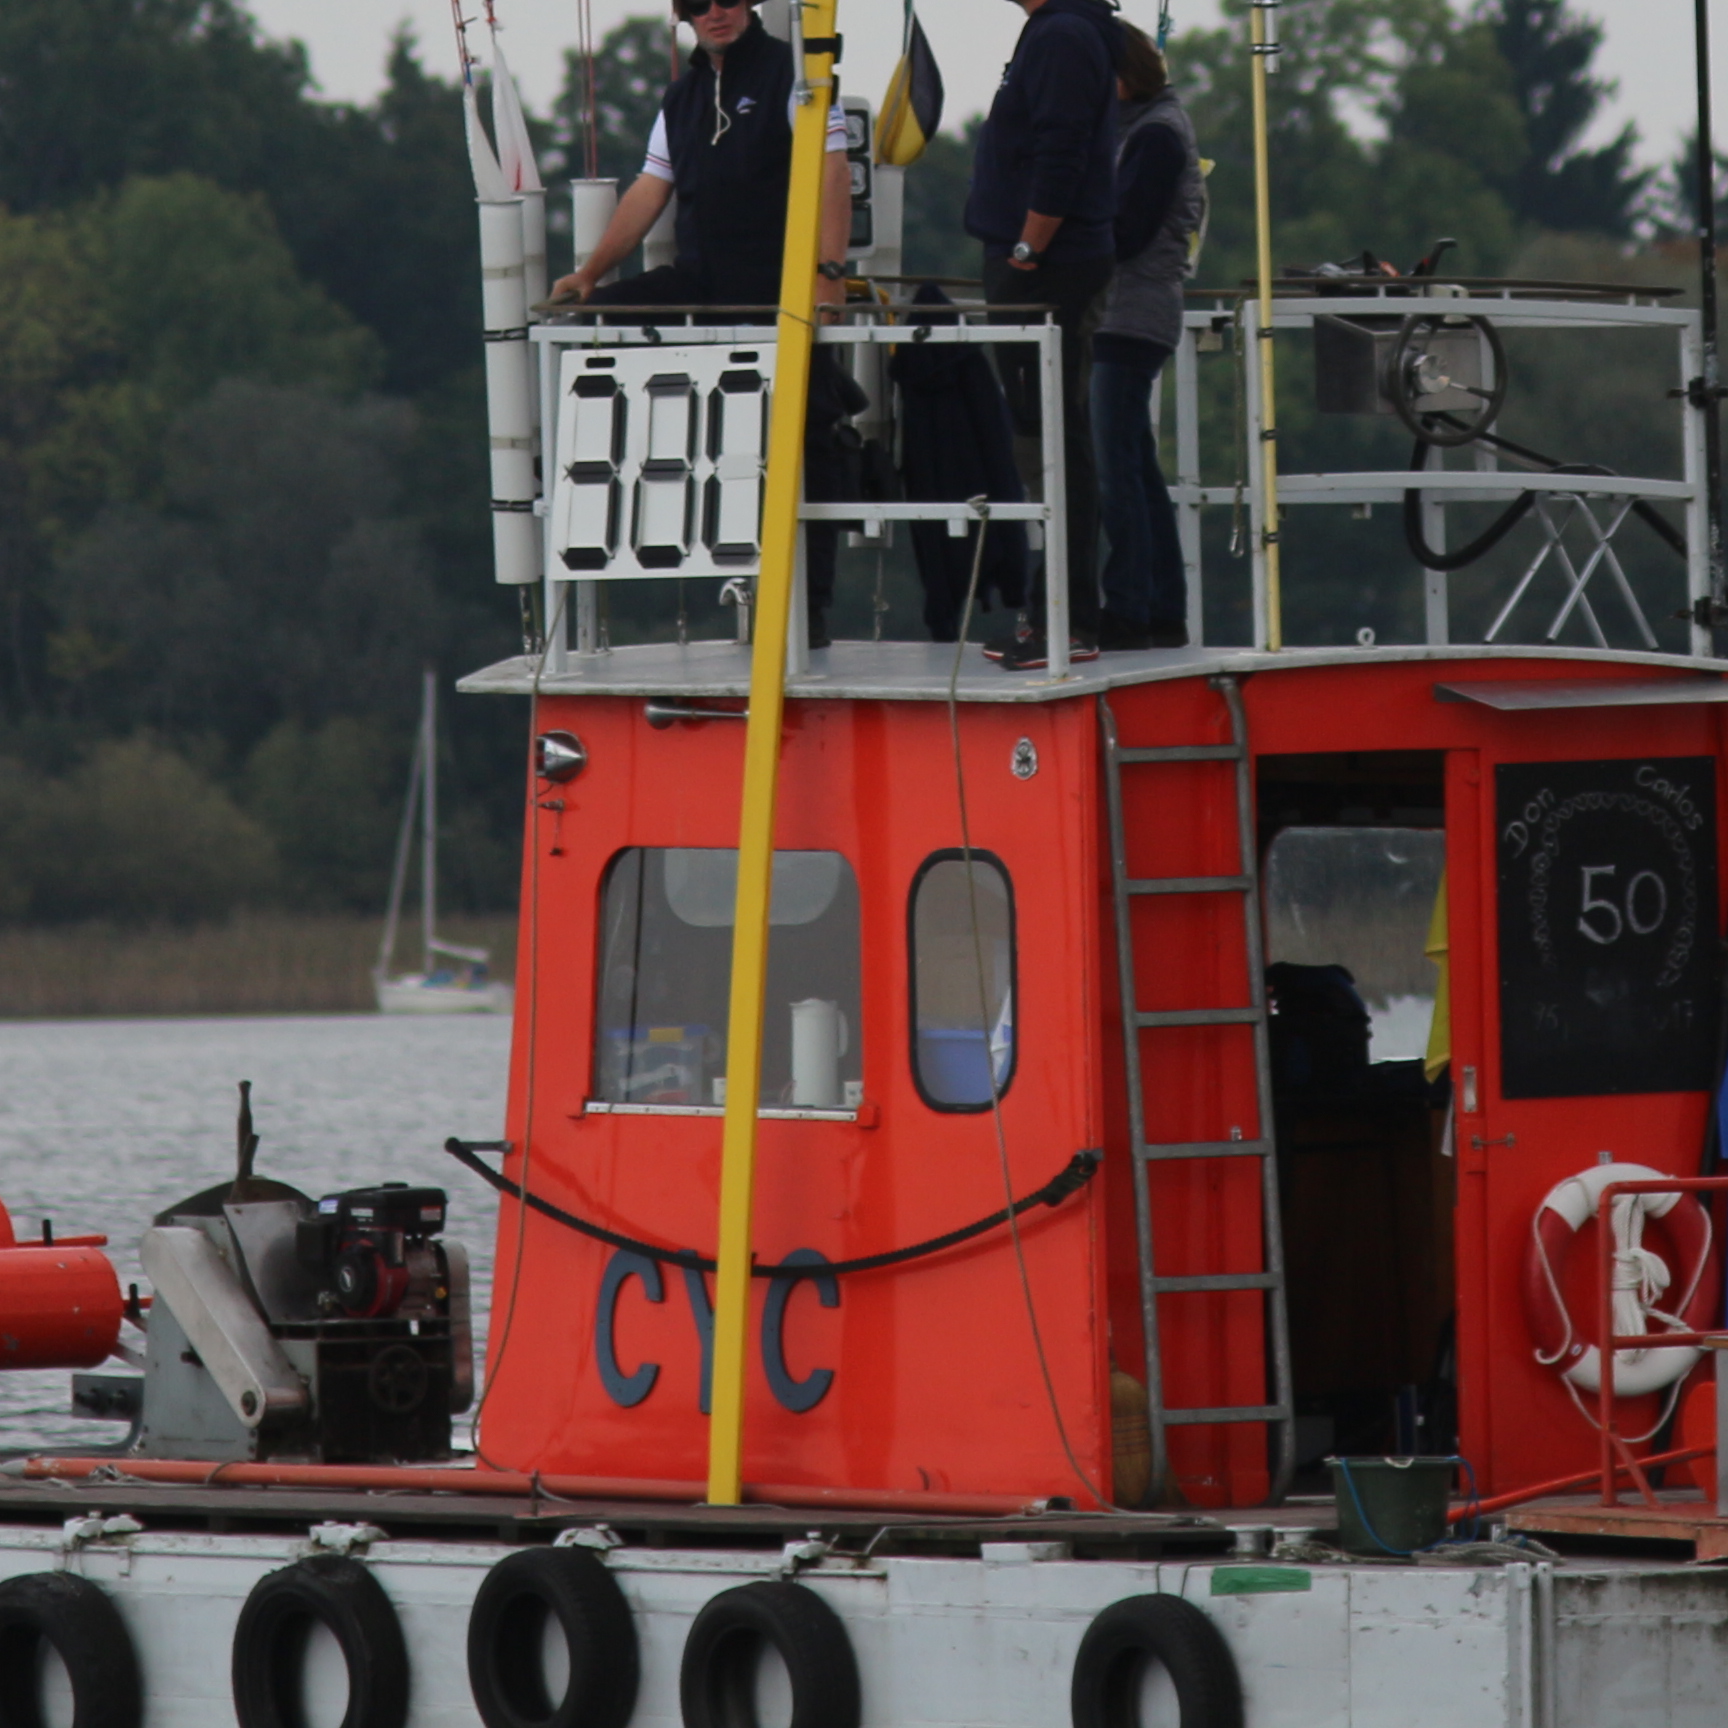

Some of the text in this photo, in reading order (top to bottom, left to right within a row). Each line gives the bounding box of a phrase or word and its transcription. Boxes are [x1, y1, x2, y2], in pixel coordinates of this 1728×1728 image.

[1503, 766, 1704, 858] Don Carlos
[1577, 864, 1667, 945] 50
